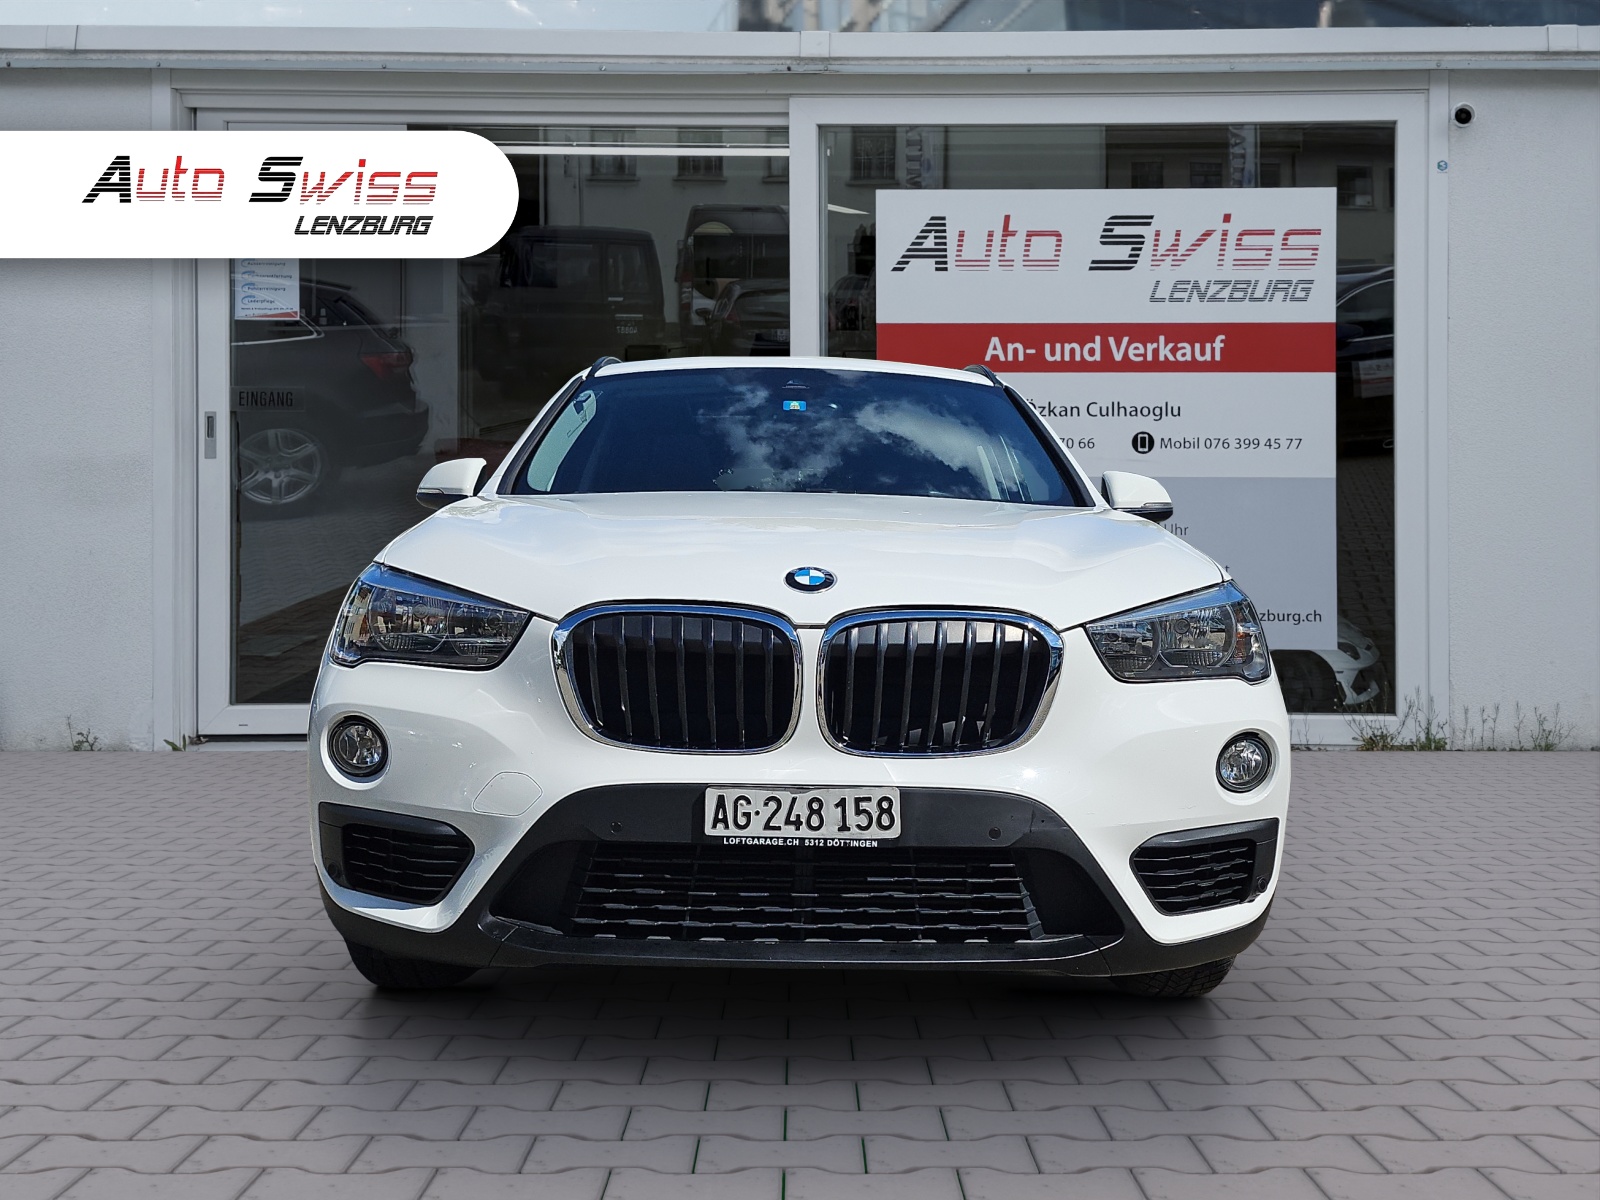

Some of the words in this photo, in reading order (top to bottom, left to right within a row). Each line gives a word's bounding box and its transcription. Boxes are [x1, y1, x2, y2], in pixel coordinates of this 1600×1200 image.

[891, 214, 1063, 272] Auto
[1088, 213, 1322, 272] Swiss
[1149, 279, 1315, 303] LENZBURG
[984, 336, 1037, 363] An-
[1044, 336, 1101, 362] und
[1108, 335, 1226, 362] Verkauf
[238, 391, 293, 407] EINGANG
[1086, 401, 1181, 422] Culhaoglu
[1078, 437, 1096, 449] 66
[1159, 436, 1200, 450] Mobil
[1203, 437, 1231, 450] 076
[1233, 437, 1261, 450] 399
[1263, 437, 1282, 450] 45
[1285, 437, 1303, 450] 77
[723, 837, 800, 847] LOFTGARAGE.CH
[804, 839, 824, 847] 5312
